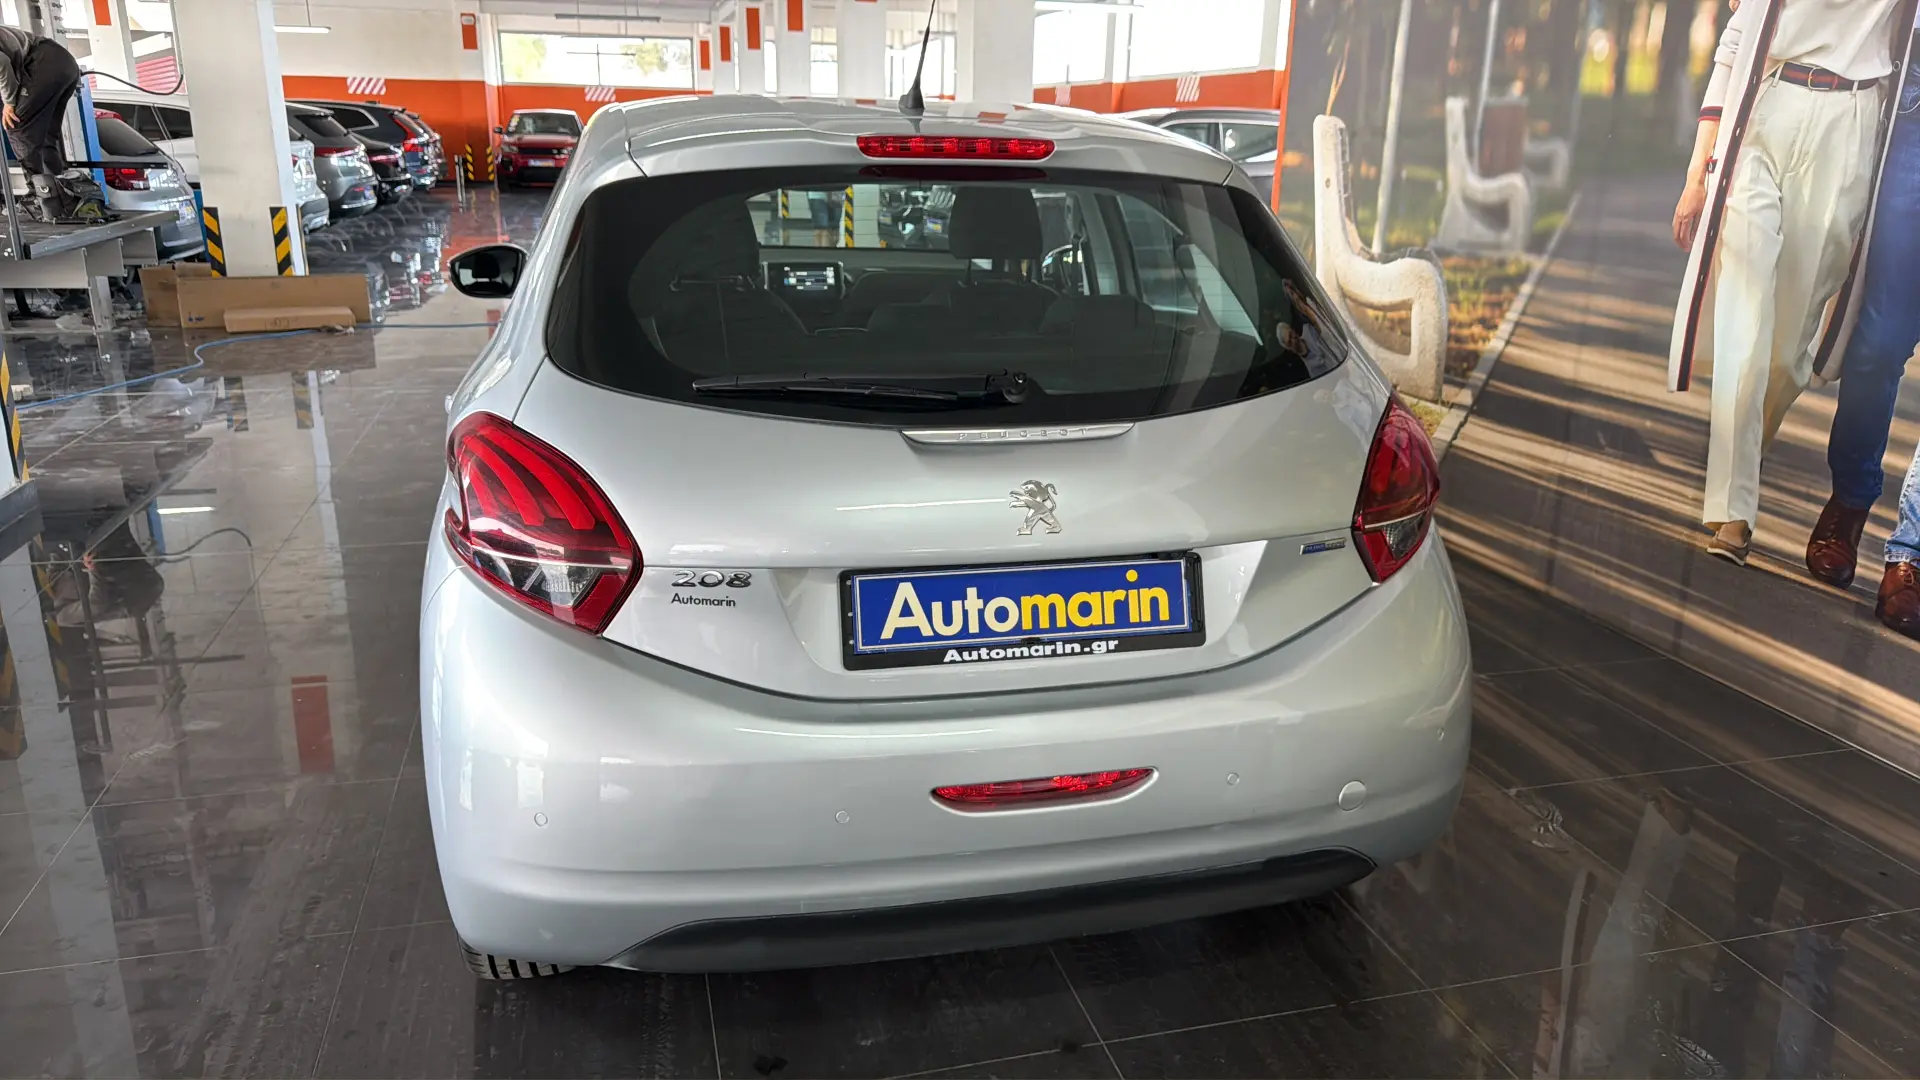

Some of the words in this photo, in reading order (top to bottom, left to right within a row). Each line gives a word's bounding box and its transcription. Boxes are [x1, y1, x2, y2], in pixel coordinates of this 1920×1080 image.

[671, 570, 752, 588] 208
[671, 592, 736, 607] Automarin
[881, 569, 1170, 640] Automarin
[943, 638, 1119, 663] Automarin.gr
